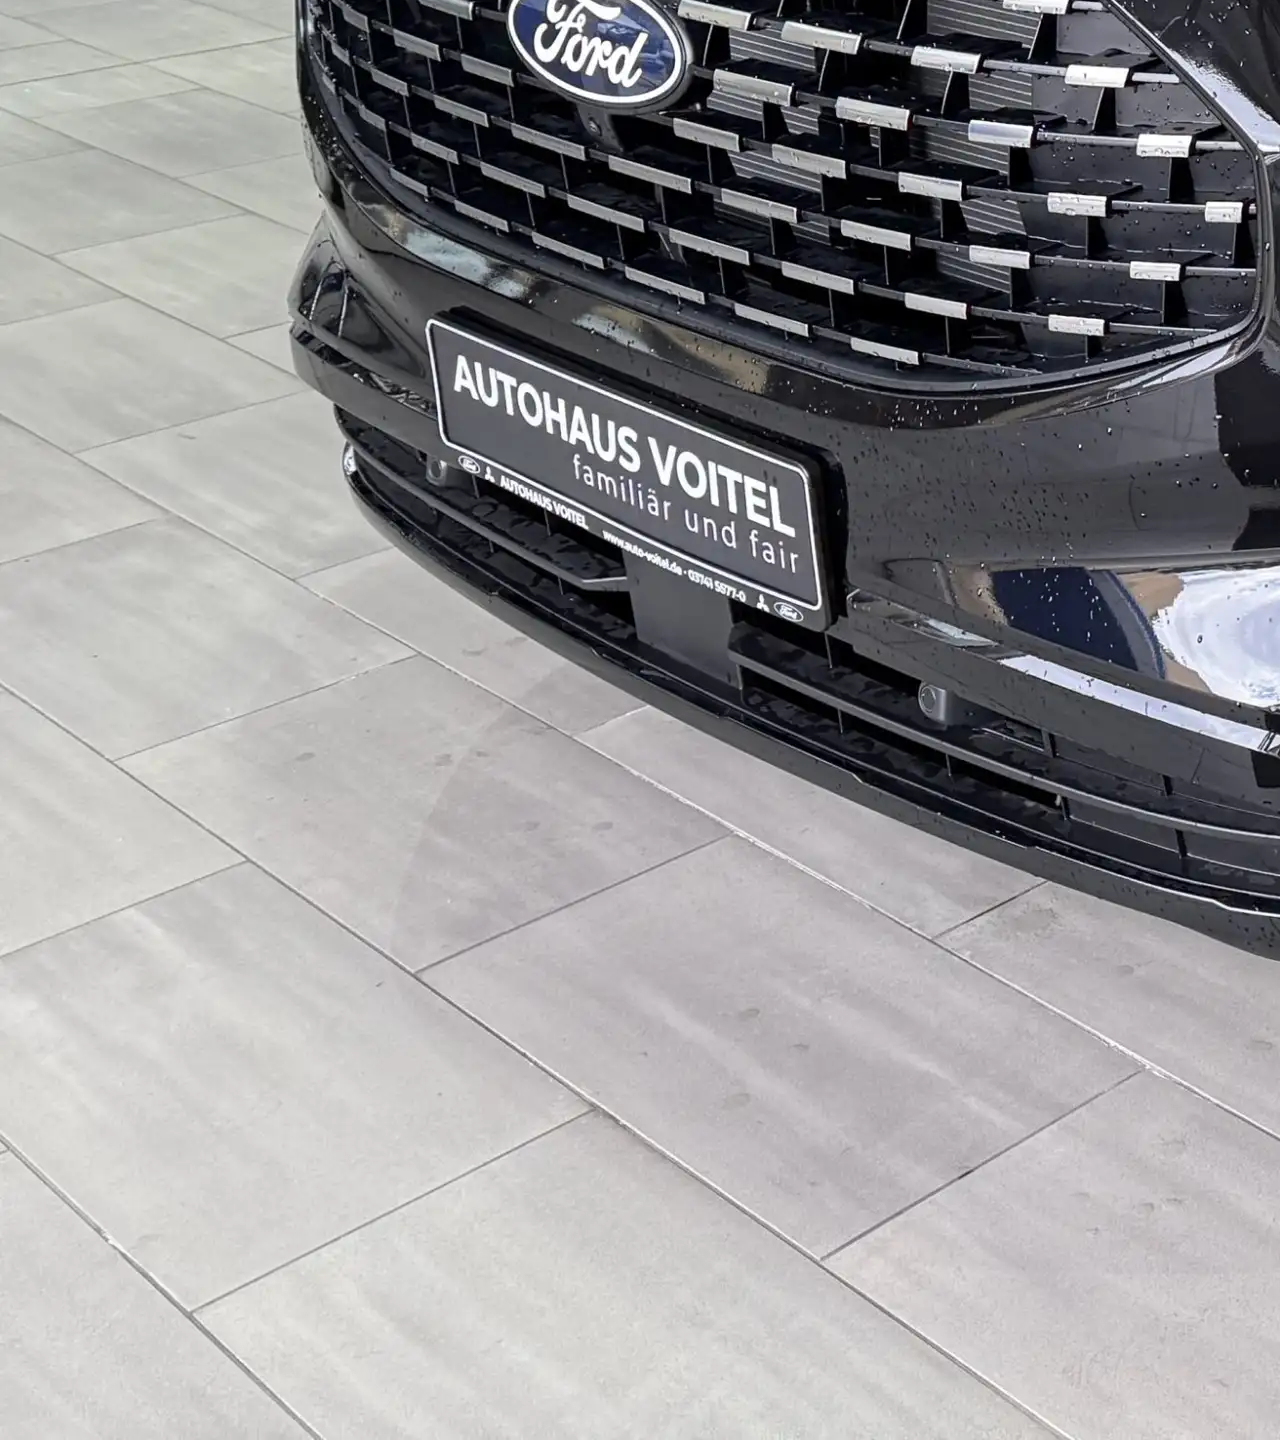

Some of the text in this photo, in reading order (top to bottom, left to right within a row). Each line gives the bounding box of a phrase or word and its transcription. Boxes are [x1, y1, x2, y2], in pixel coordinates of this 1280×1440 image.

[453, 354, 796, 538] AUTOHAUS VOITEL
[500, 475, 552, 511] AUTOHAUS
[552, 501, 589, 530] VOITEL
[602, 530, 683, 576] www.auto-voitel.de
[687, 569, 714, 590] 03741
[572, 454, 799, 574] familiär und fair
